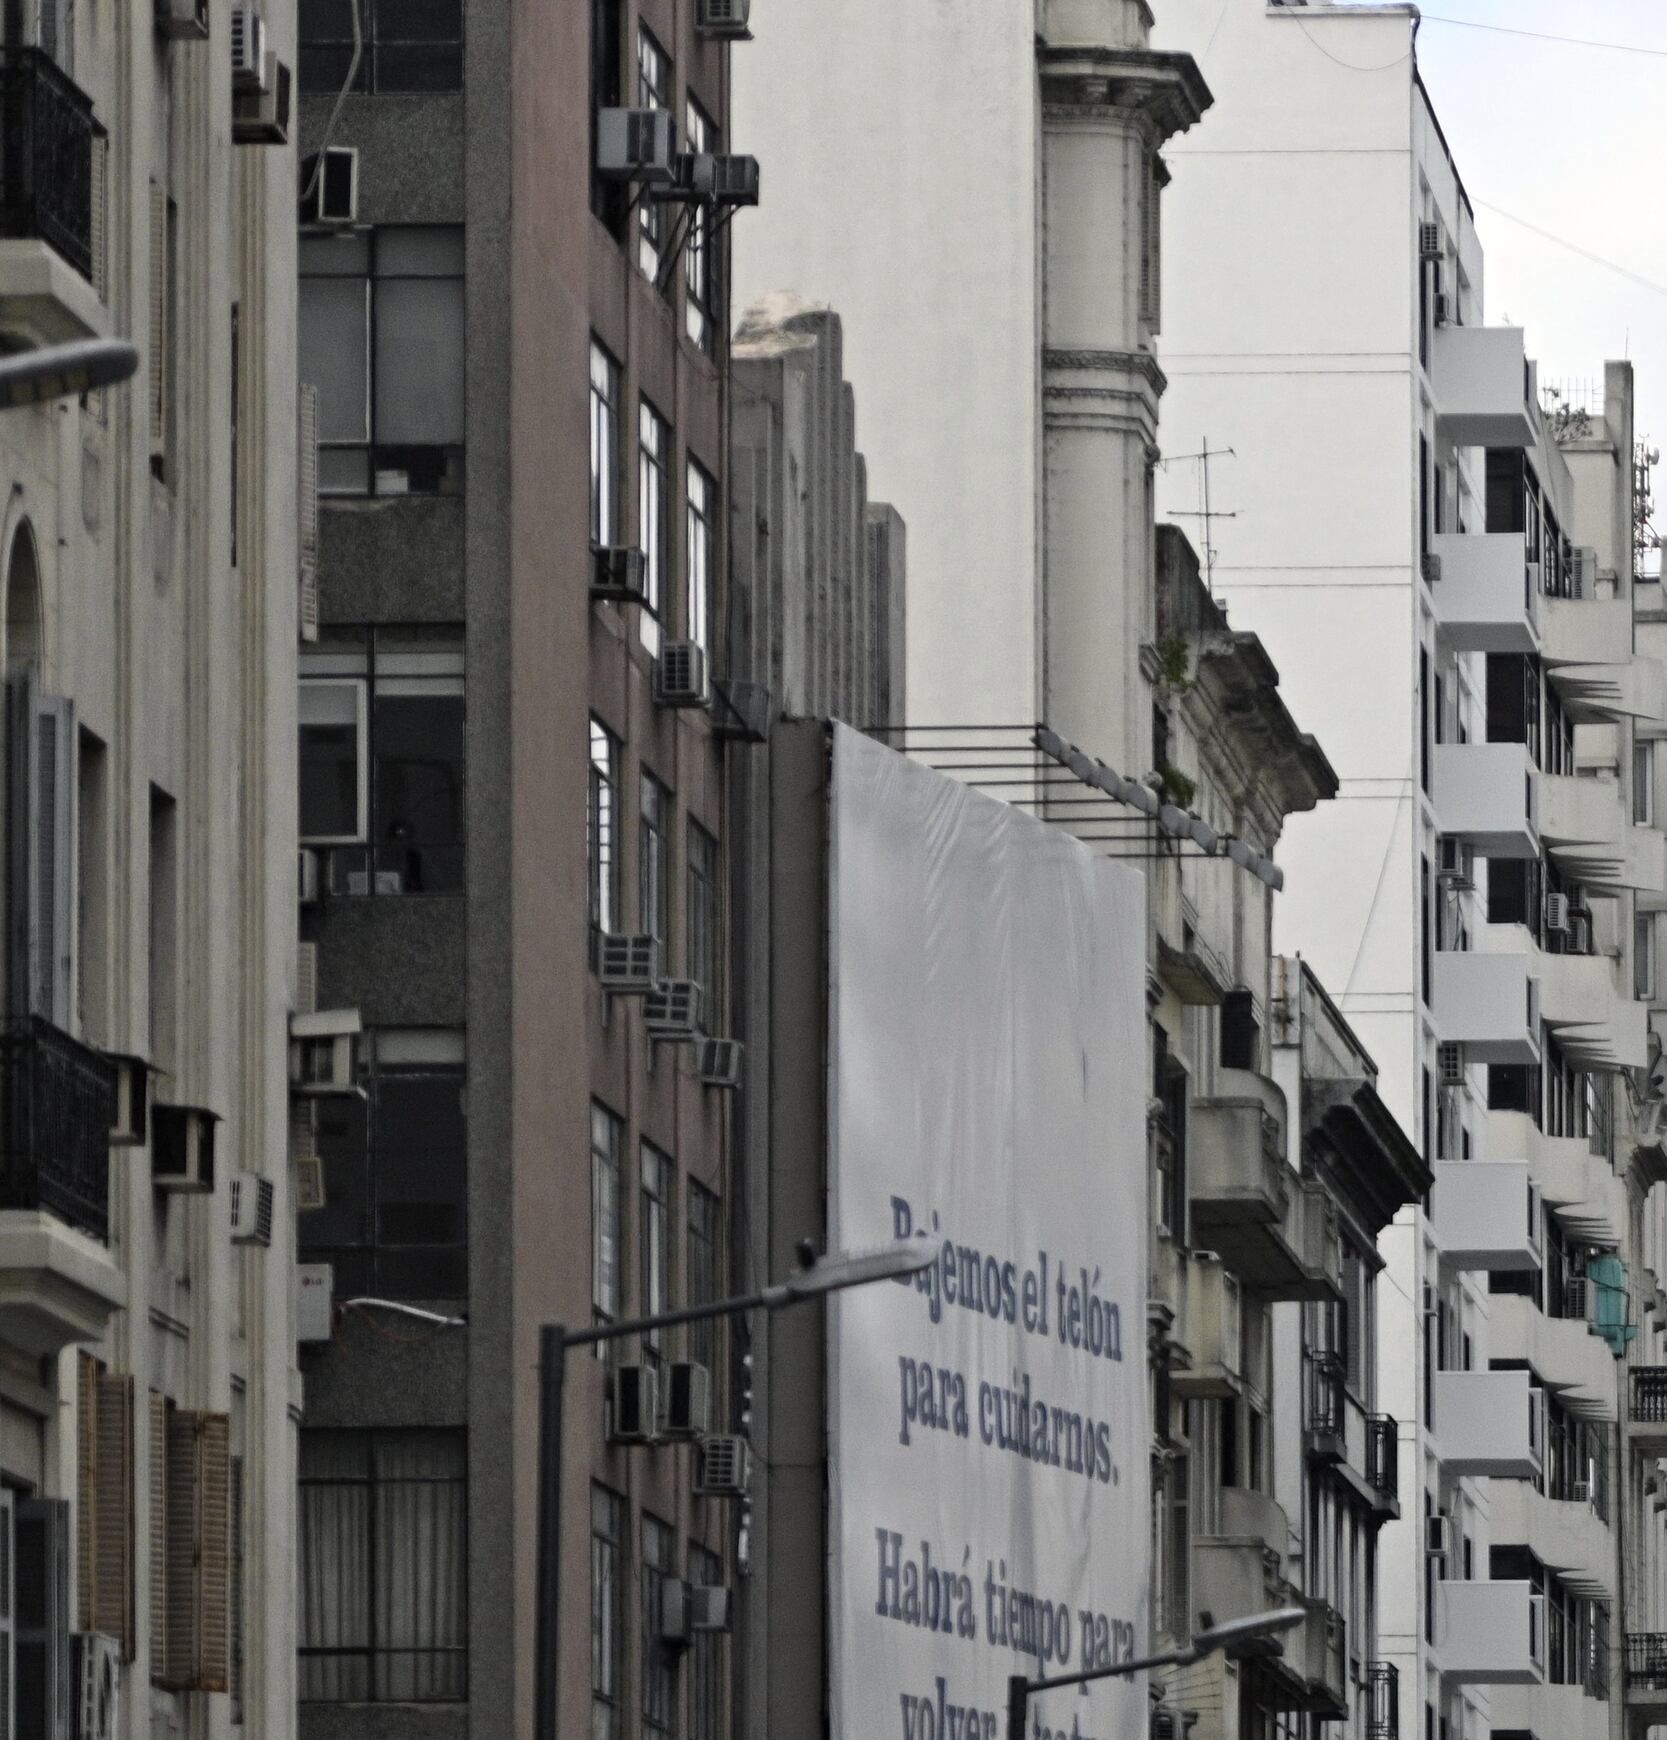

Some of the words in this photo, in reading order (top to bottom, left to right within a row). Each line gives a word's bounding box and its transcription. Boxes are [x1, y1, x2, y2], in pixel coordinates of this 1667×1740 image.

[1022, 1249, 1049, 1337] el
[1056, 1258, 1122, 1363] telón
[898, 1353, 970, 1446] para
[978, 1366, 1119, 1486] cuidarnos.
[874, 1526, 977, 1642] Habrá
[984, 1558, 1071, 1682] tiempo
[1080, 1608, 1137, 1696] para
